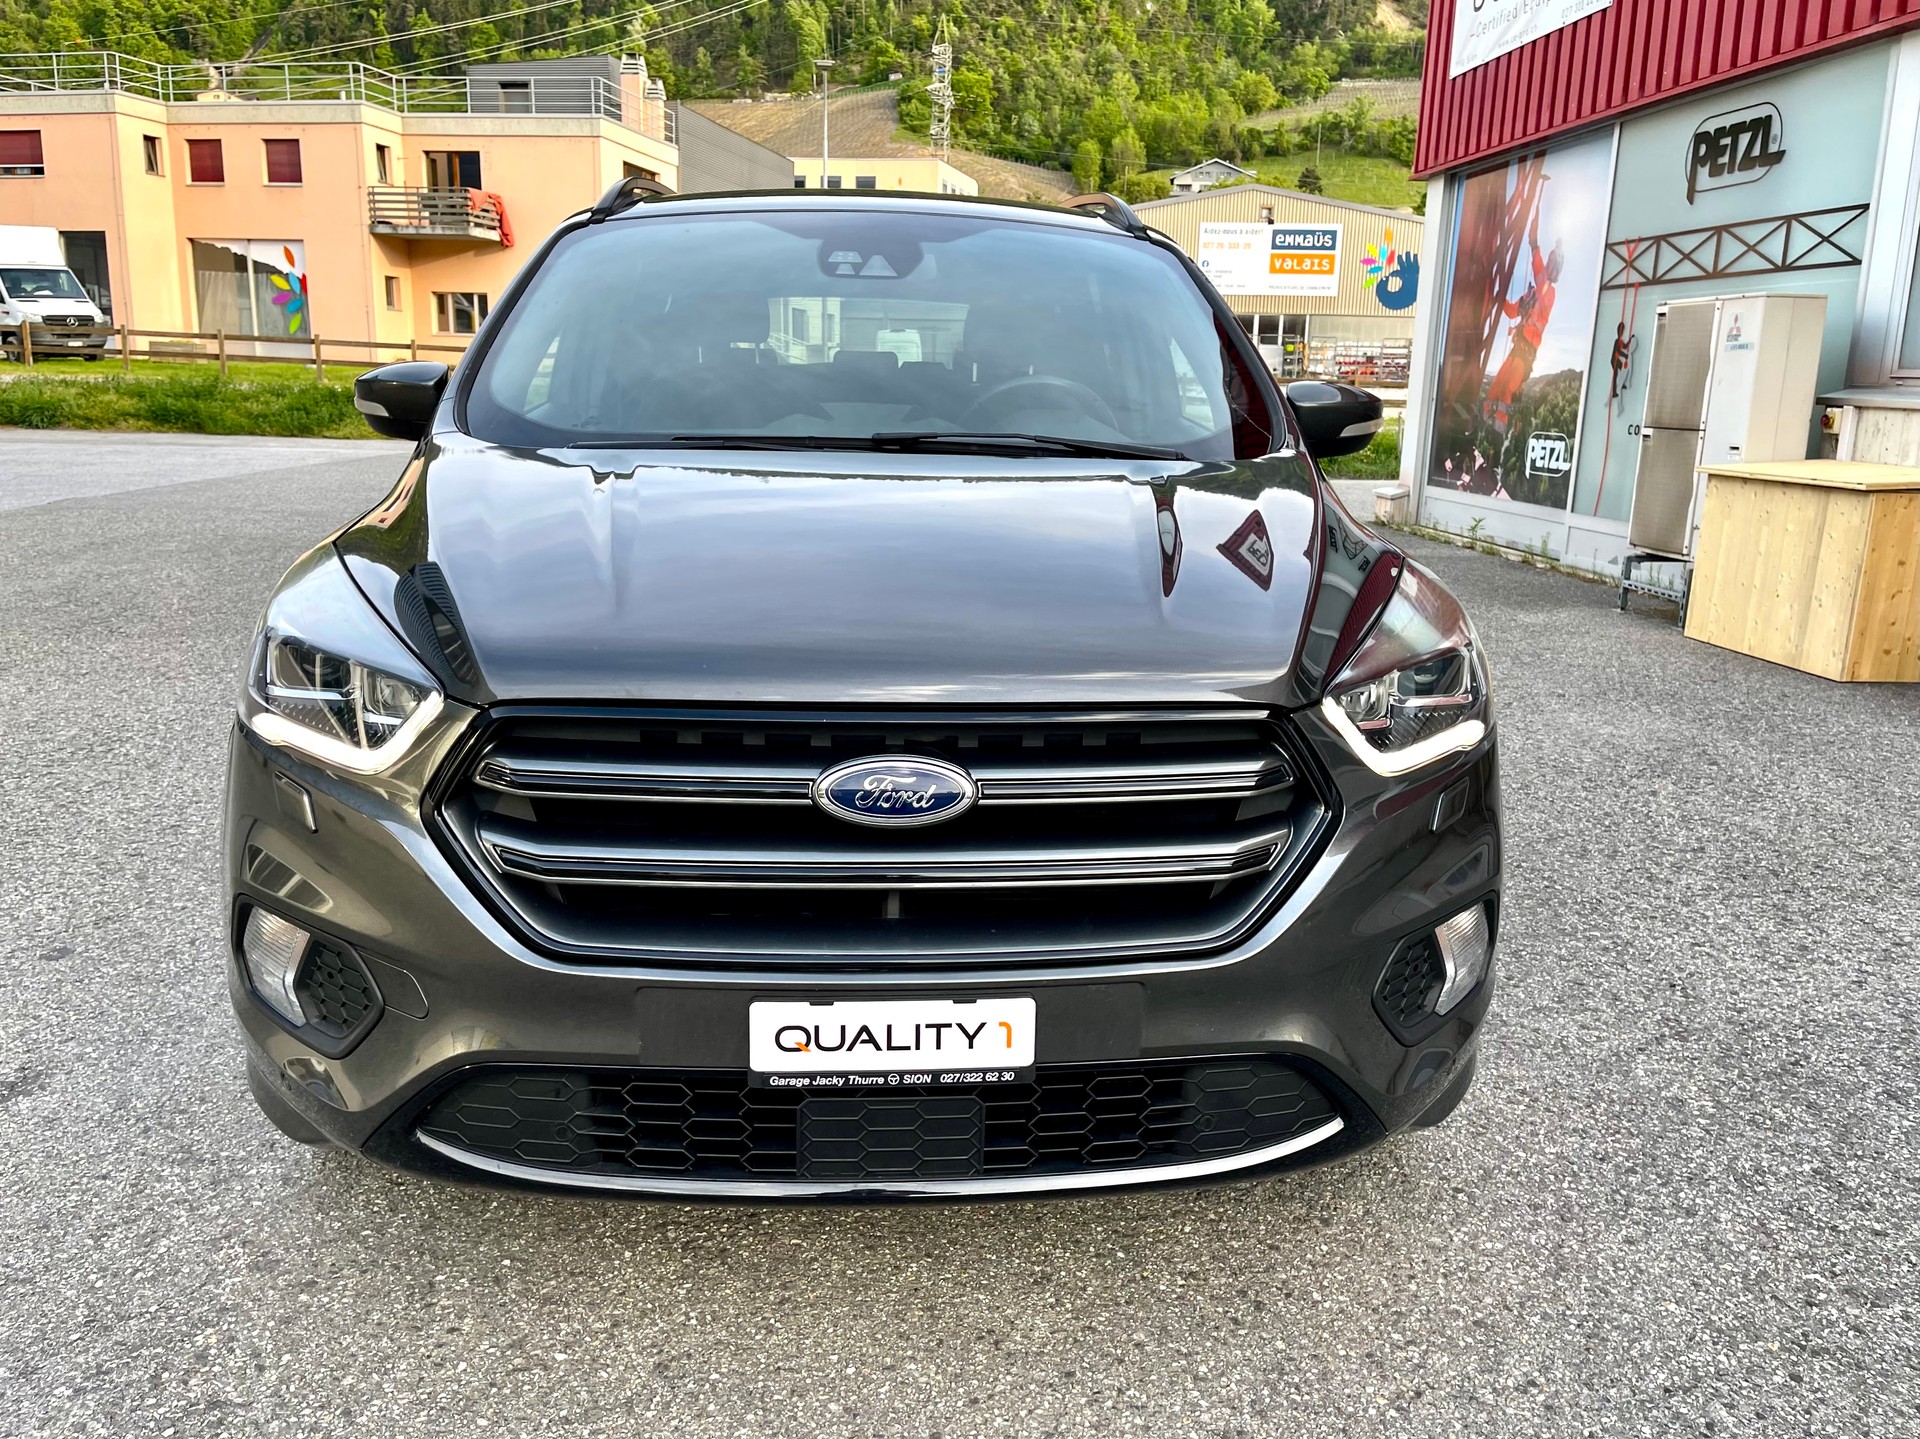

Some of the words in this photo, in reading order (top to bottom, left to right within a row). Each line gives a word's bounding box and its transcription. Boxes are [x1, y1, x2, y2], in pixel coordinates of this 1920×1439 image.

[1686, 114, 1786, 205] PETZL
[1525, 438, 1571, 479] PETZL
[855, 774, 937, 809] Ford
[774, 1022, 987, 1053] QUALITY
[998, 1021, 1013, 1048] 1
[769, 1075, 811, 1088] Garage
[812, 1075, 846, 1087] Jacky
[848, 1075, 885, 1085] Thurre
[902, 1074, 933, 1084] SION
[940, 1072, 984, 1083] 027/322
[985, 1071, 999, 1082] 62
[1000, 1071, 1015, 1081] 30
